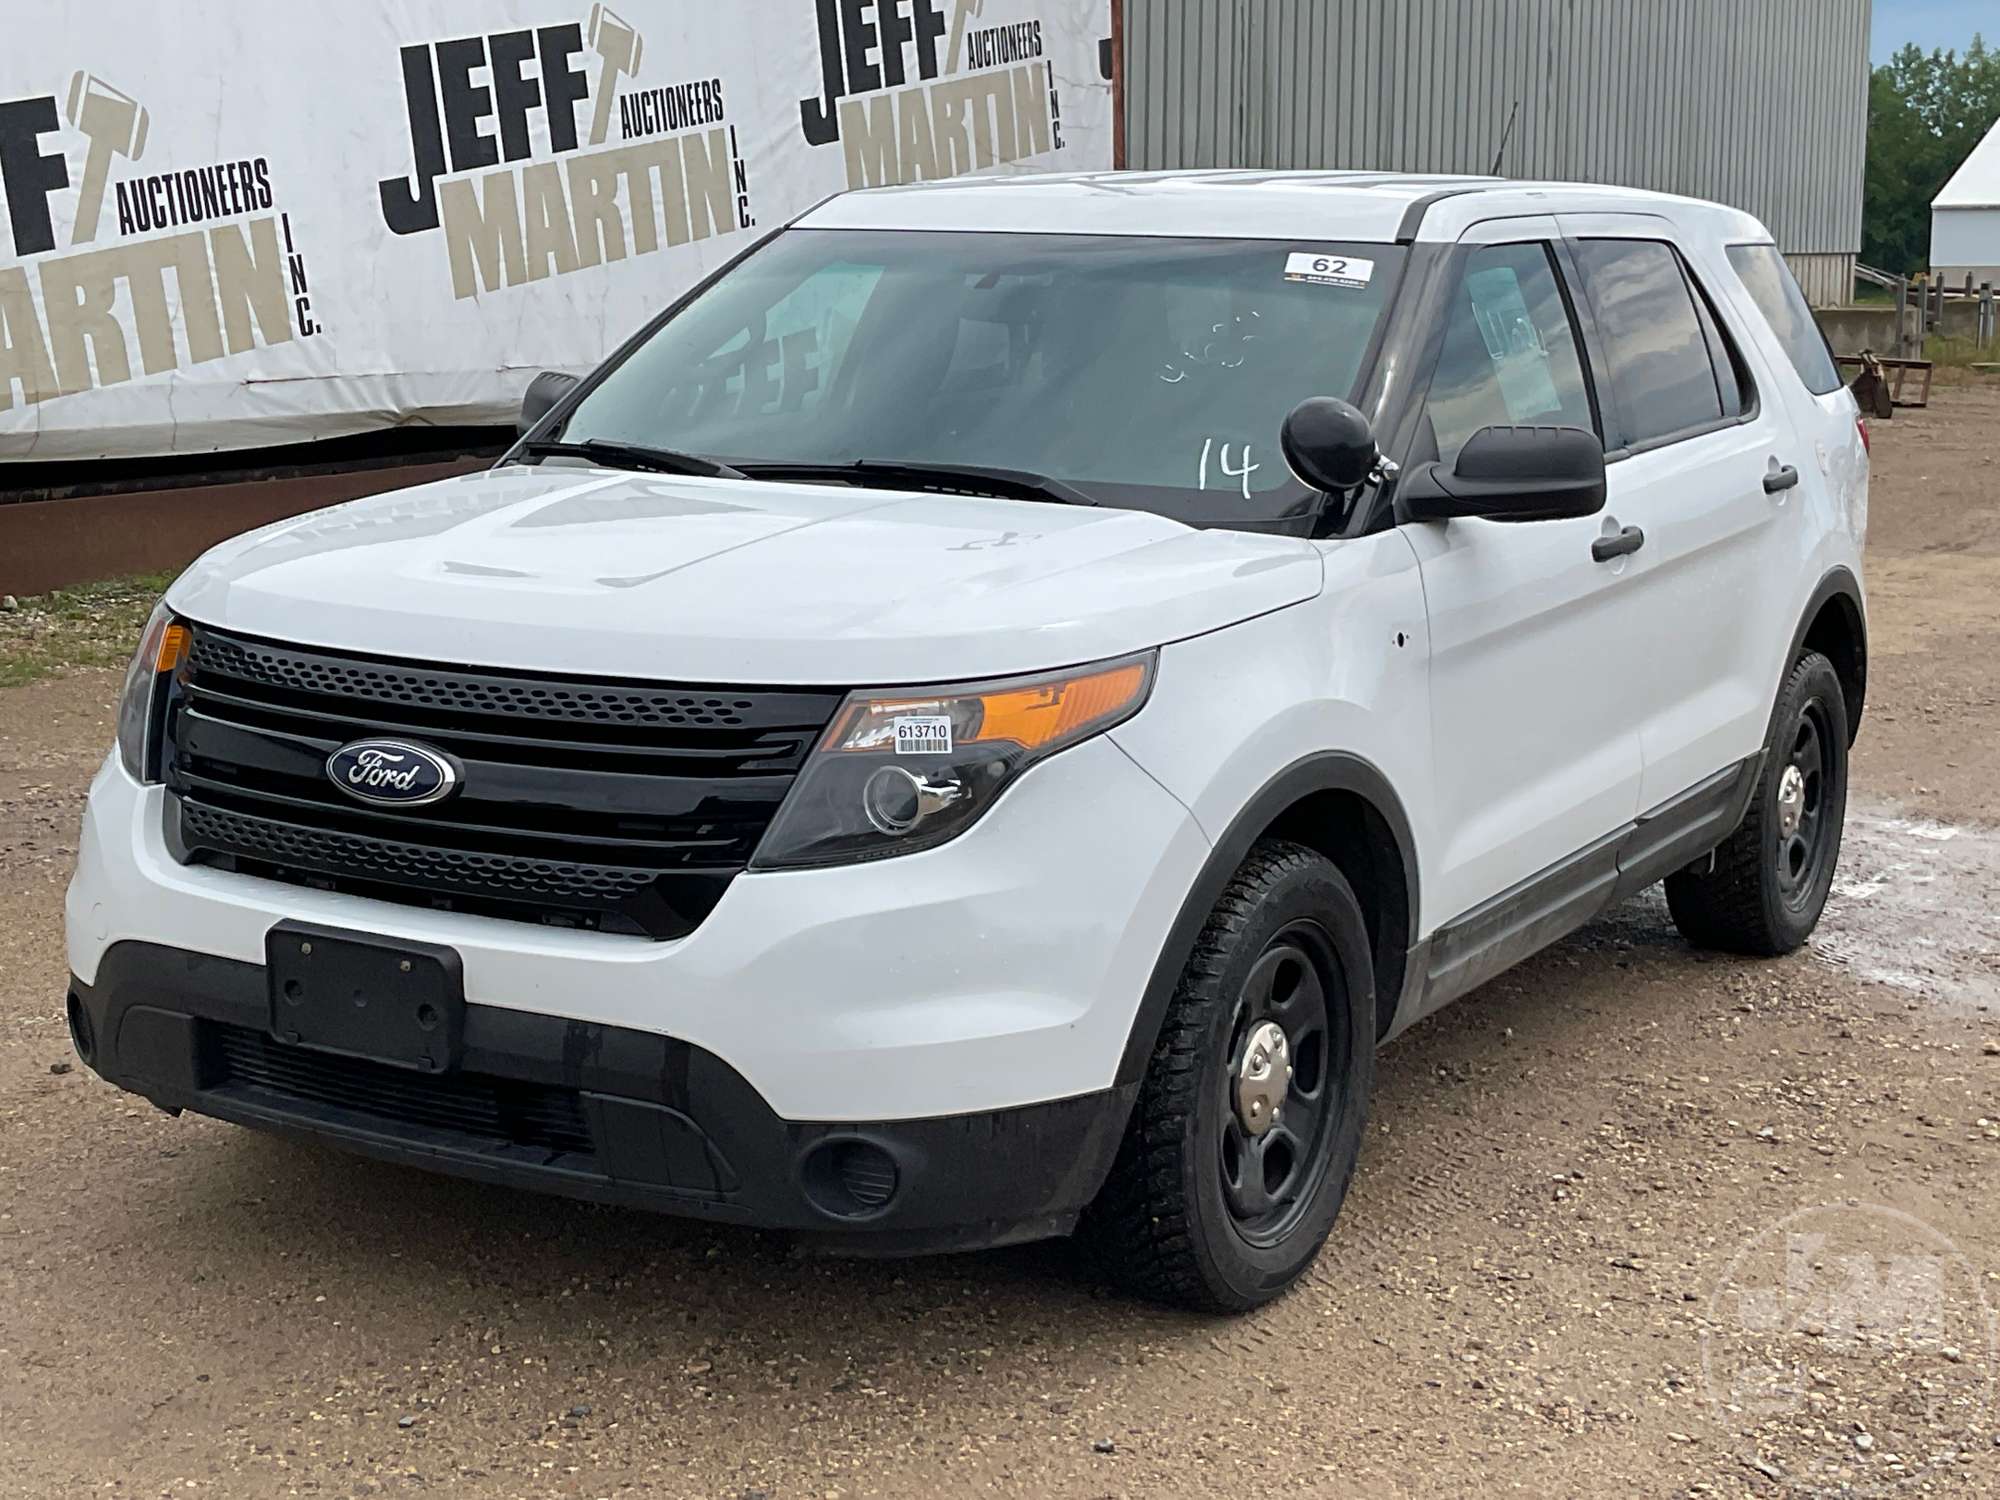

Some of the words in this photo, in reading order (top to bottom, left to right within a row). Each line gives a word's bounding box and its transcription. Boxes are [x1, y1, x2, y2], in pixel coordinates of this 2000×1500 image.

[800, 0, 946, 146] JEFF
[967, 20, 1042, 70] AUCTIONEERS
[378, 23, 589, 235] JEFF
[619, 78, 724, 140] AUCTIONEERS
[840, 62, 1051, 190] MARTIN
[116, 157, 273, 236] AUCTIONEERS
[439, 128, 736, 300] MARTIN
[1312, 258, 1348, 275] 62
[0, 217, 294, 412] ARTIN
[1199, 438, 1260, 500] 14
[898, 724, 947, 739] 613710
[348, 749, 421, 791] Ford
